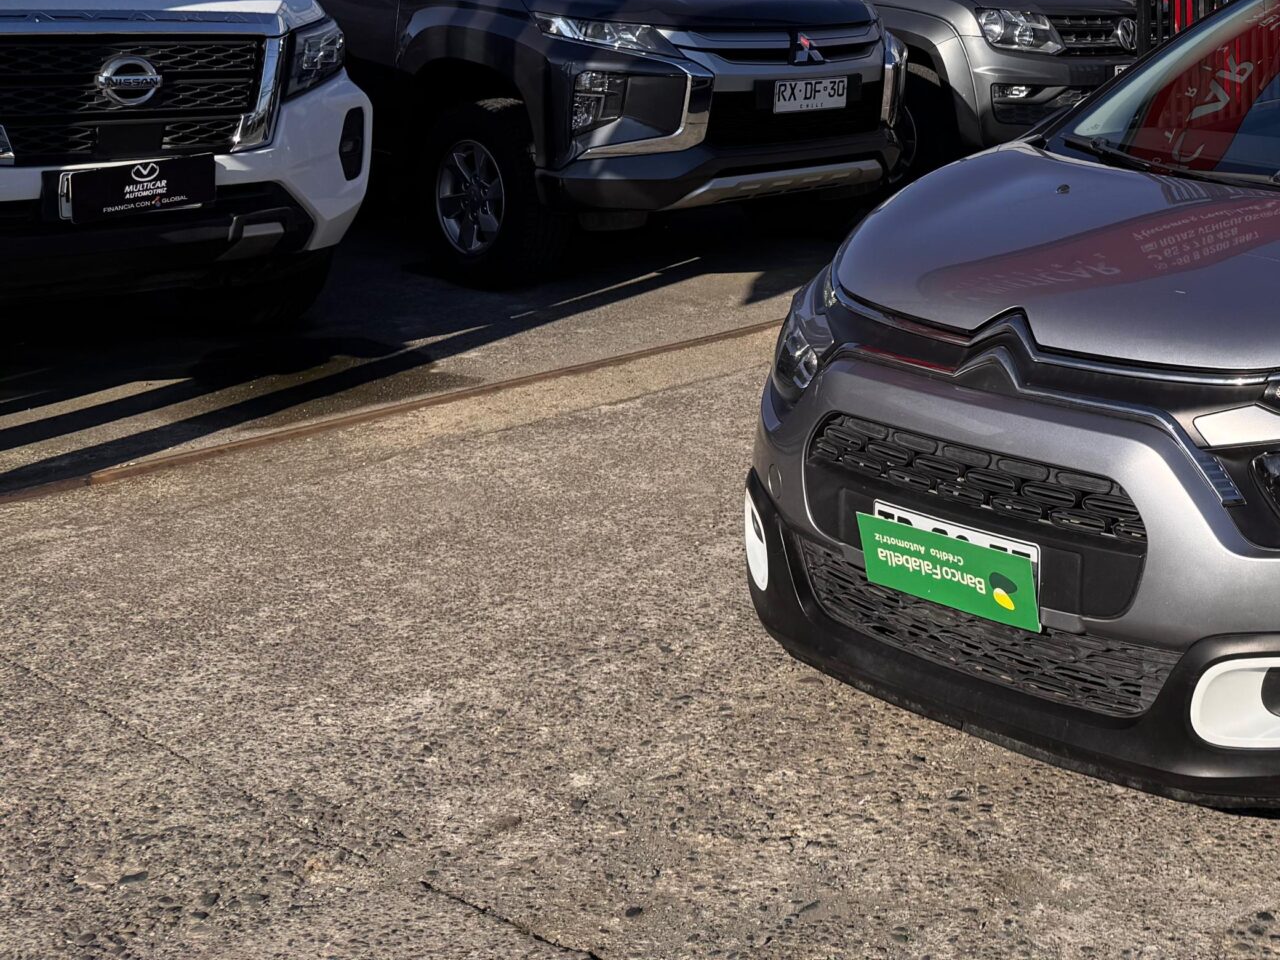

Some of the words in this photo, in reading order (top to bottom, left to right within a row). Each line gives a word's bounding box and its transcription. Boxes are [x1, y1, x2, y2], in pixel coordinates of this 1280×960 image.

[106, 76, 158, 87] NISSAN
[124, 180, 167, 193] MULTICAR
[125, 187, 167, 199] AUTOMOTRIZ
[103, 204, 134, 213] FINANCIA
[162, 195, 188, 203] GLOBAL
[874, 533, 925, 554] Automotriz
